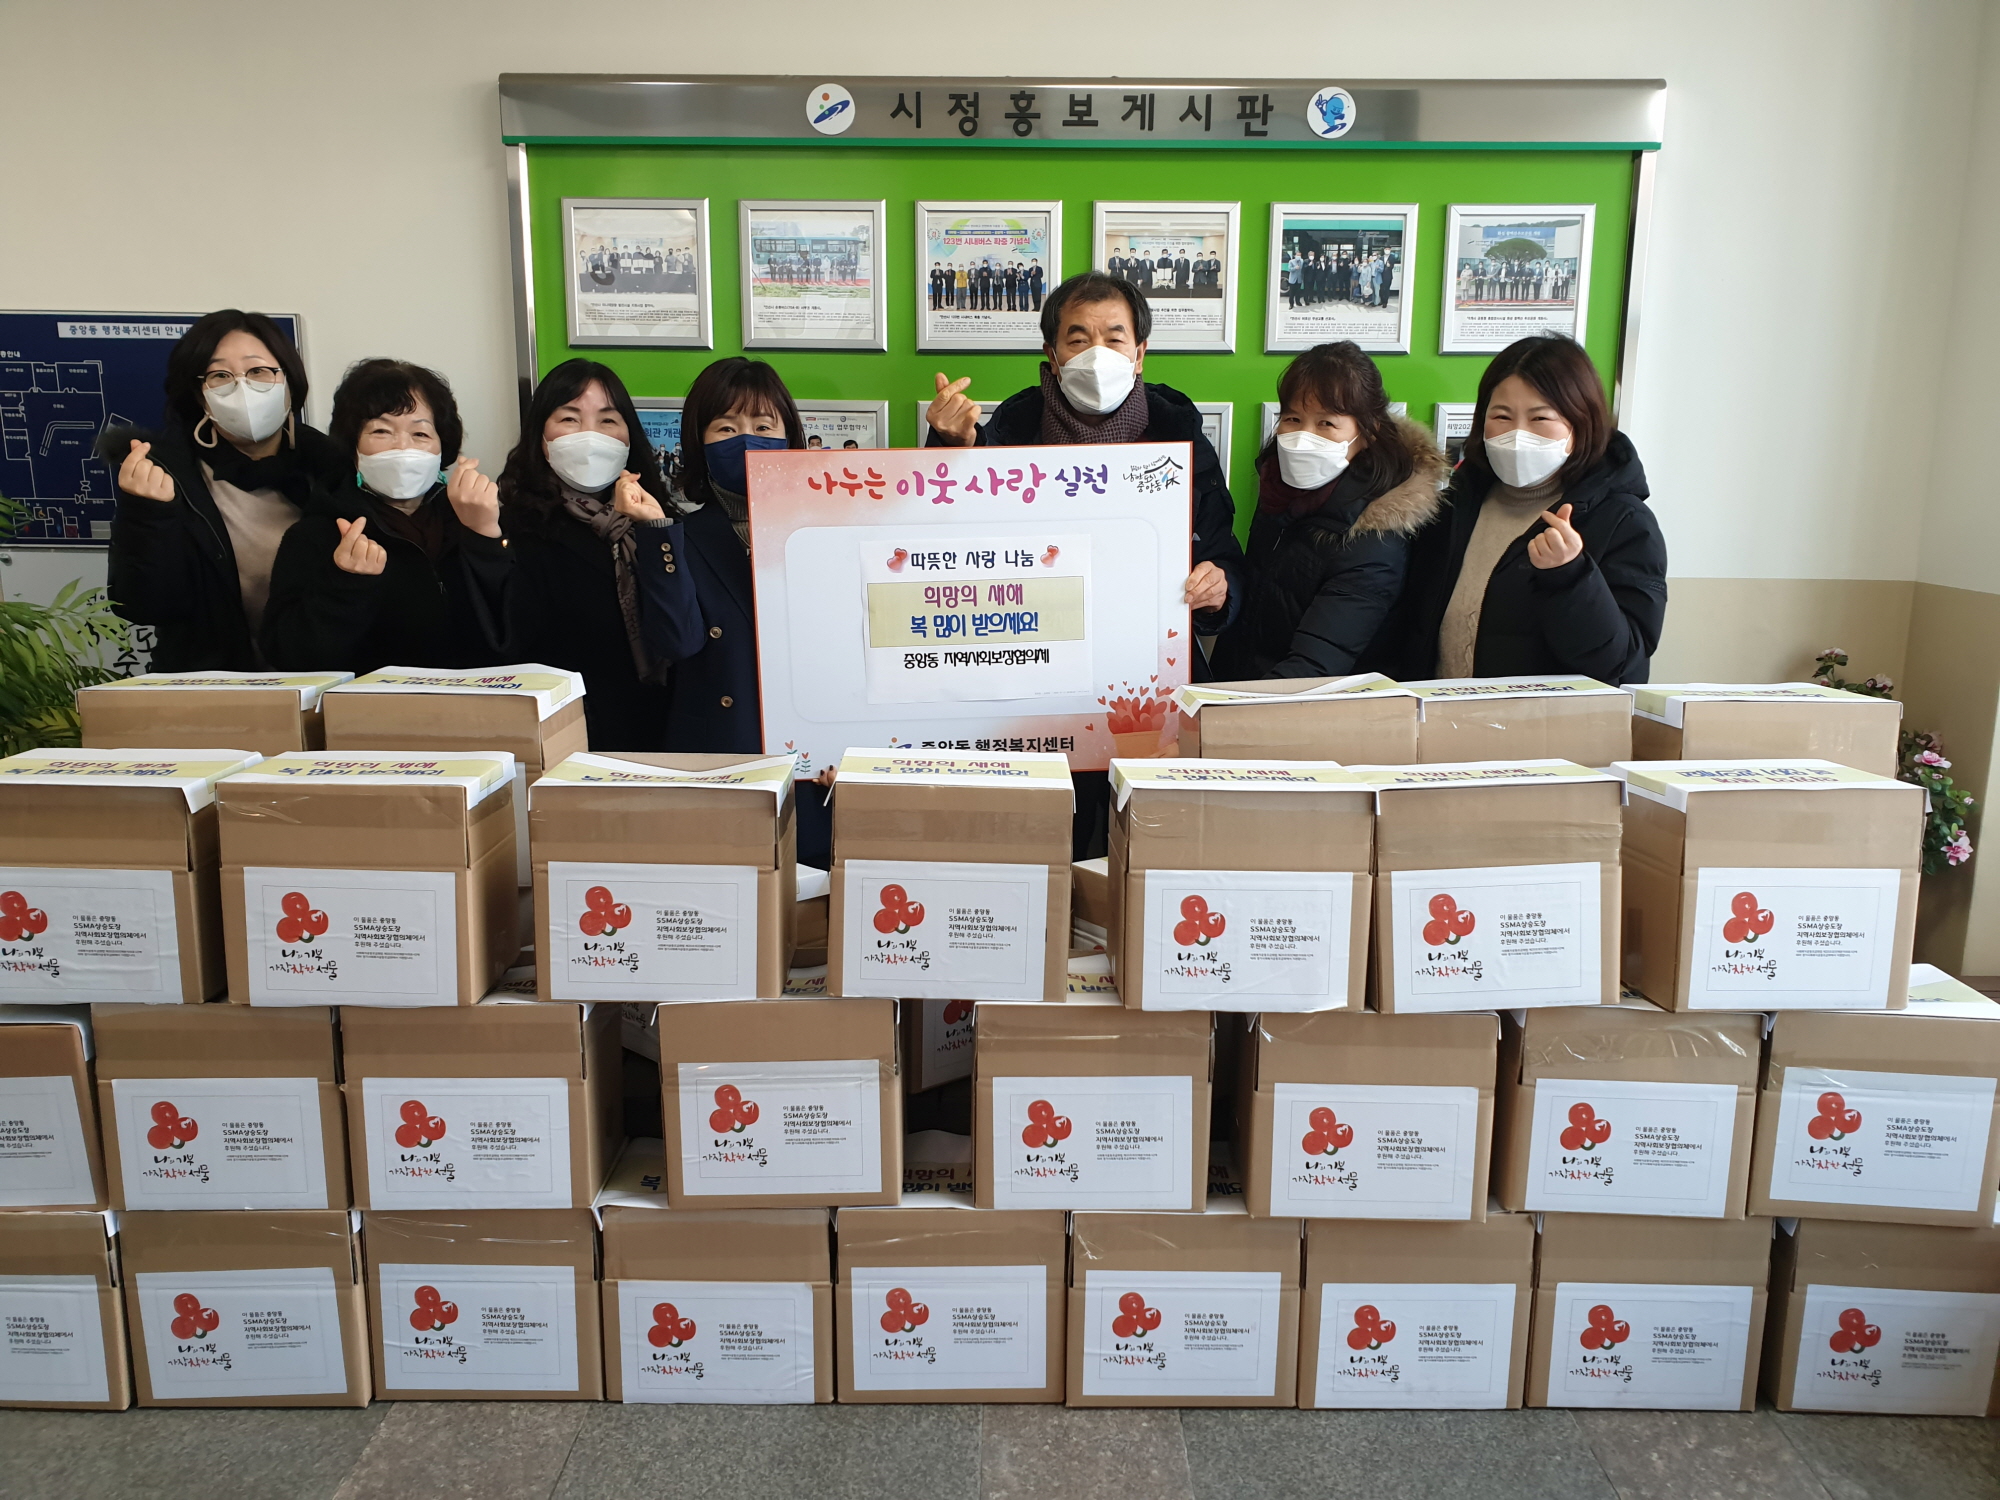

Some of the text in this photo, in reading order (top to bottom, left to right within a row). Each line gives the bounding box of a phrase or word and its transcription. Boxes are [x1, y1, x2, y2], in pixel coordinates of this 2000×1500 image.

[1010, 237, 1030, 245] 기념식
[69, 326, 97, 335] 중앙동
[102, 326, 160, 335] 행정복지센터
[807, 462, 1108, 505] 나누는 이웃 사랑 실천
[1137, 480, 1161, 493] 중앙동
[911, 550, 1034, 570] 따뜻한 사랑 나눔
[924, 583, 1024, 607] 희망의 새해
[911, 612, 1038, 637] 복 많이 받으세요!
[903, 648, 1050, 668] 중앙동 지역사회보장협의체
[656, 917, 702, 925] SSMA상승도장
[1500, 919, 1546, 930] SSMA상승도장
[1250, 926, 1296, 934] SSMA상승도장
[1797, 922, 1842, 930] SSMA상승도장
[783, 1112, 828, 1120] SSMA상승도장
[223, 1128, 268, 1137] SSMA상승도장
[470, 1128, 516, 1136] SSMA상승도장
[1096, 1127, 1140, 1136] SSMA상승도장
[1886, 1124, 1933, 1133] SSMA상승도장
[243, 1317, 287, 1326] SSMA상승도장
[952, 1313, 995, 1321] SSMA상승도장
[1418, 1331, 1461, 1339] SSMA상승도장
